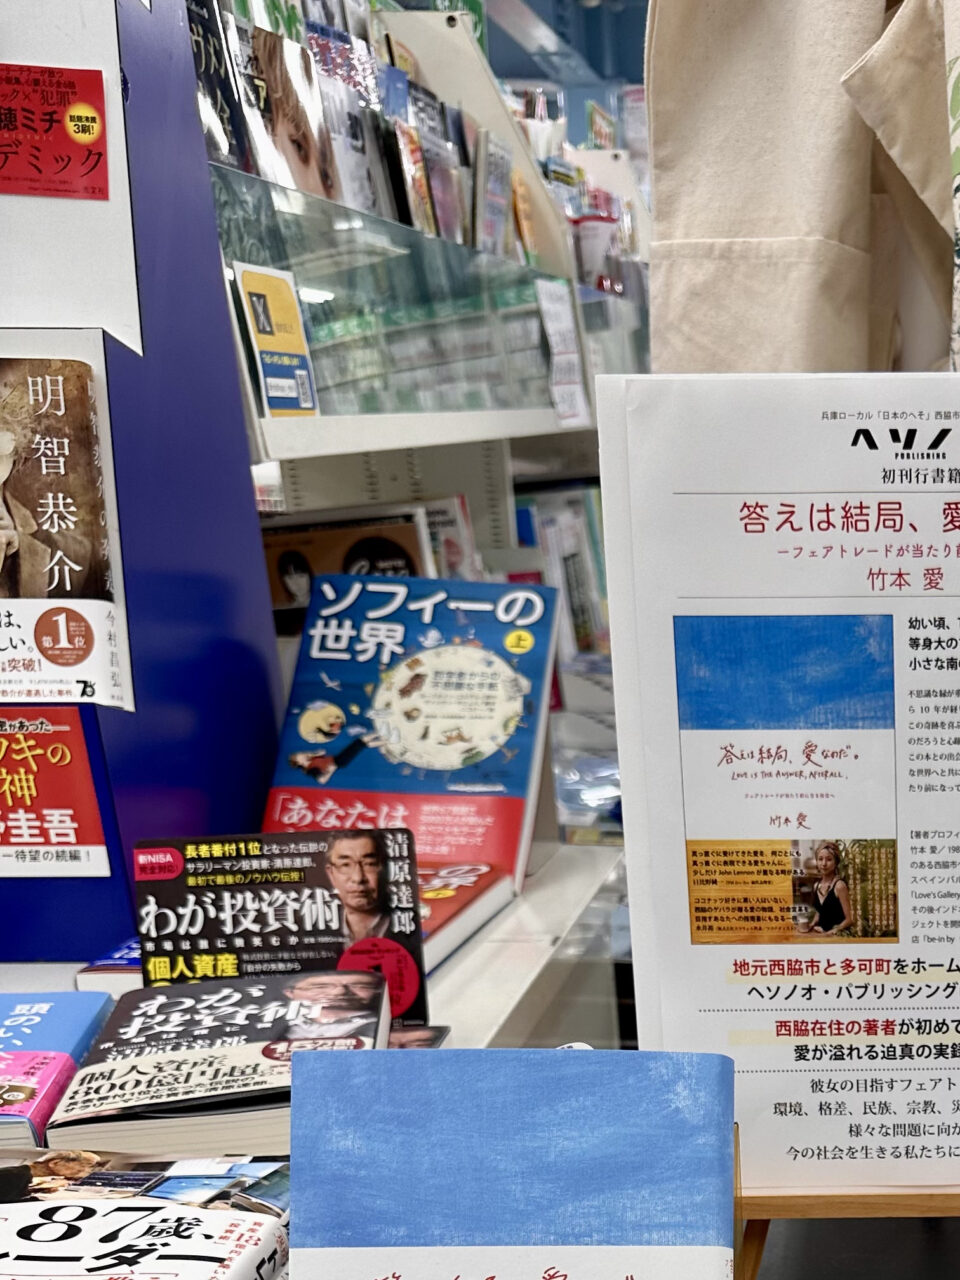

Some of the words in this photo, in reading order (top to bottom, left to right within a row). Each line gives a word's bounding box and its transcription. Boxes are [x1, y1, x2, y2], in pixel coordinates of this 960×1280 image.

[27, 375, 83, 591] 明智恭介
[319, 581, 545, 627] ソフィーの
[308, 618, 406, 664] 世界
[139, 886, 342, 939] わが投資術
[148, 953, 240, 980] 個人資産
[0, 1242, 228, 1274] ーダー
